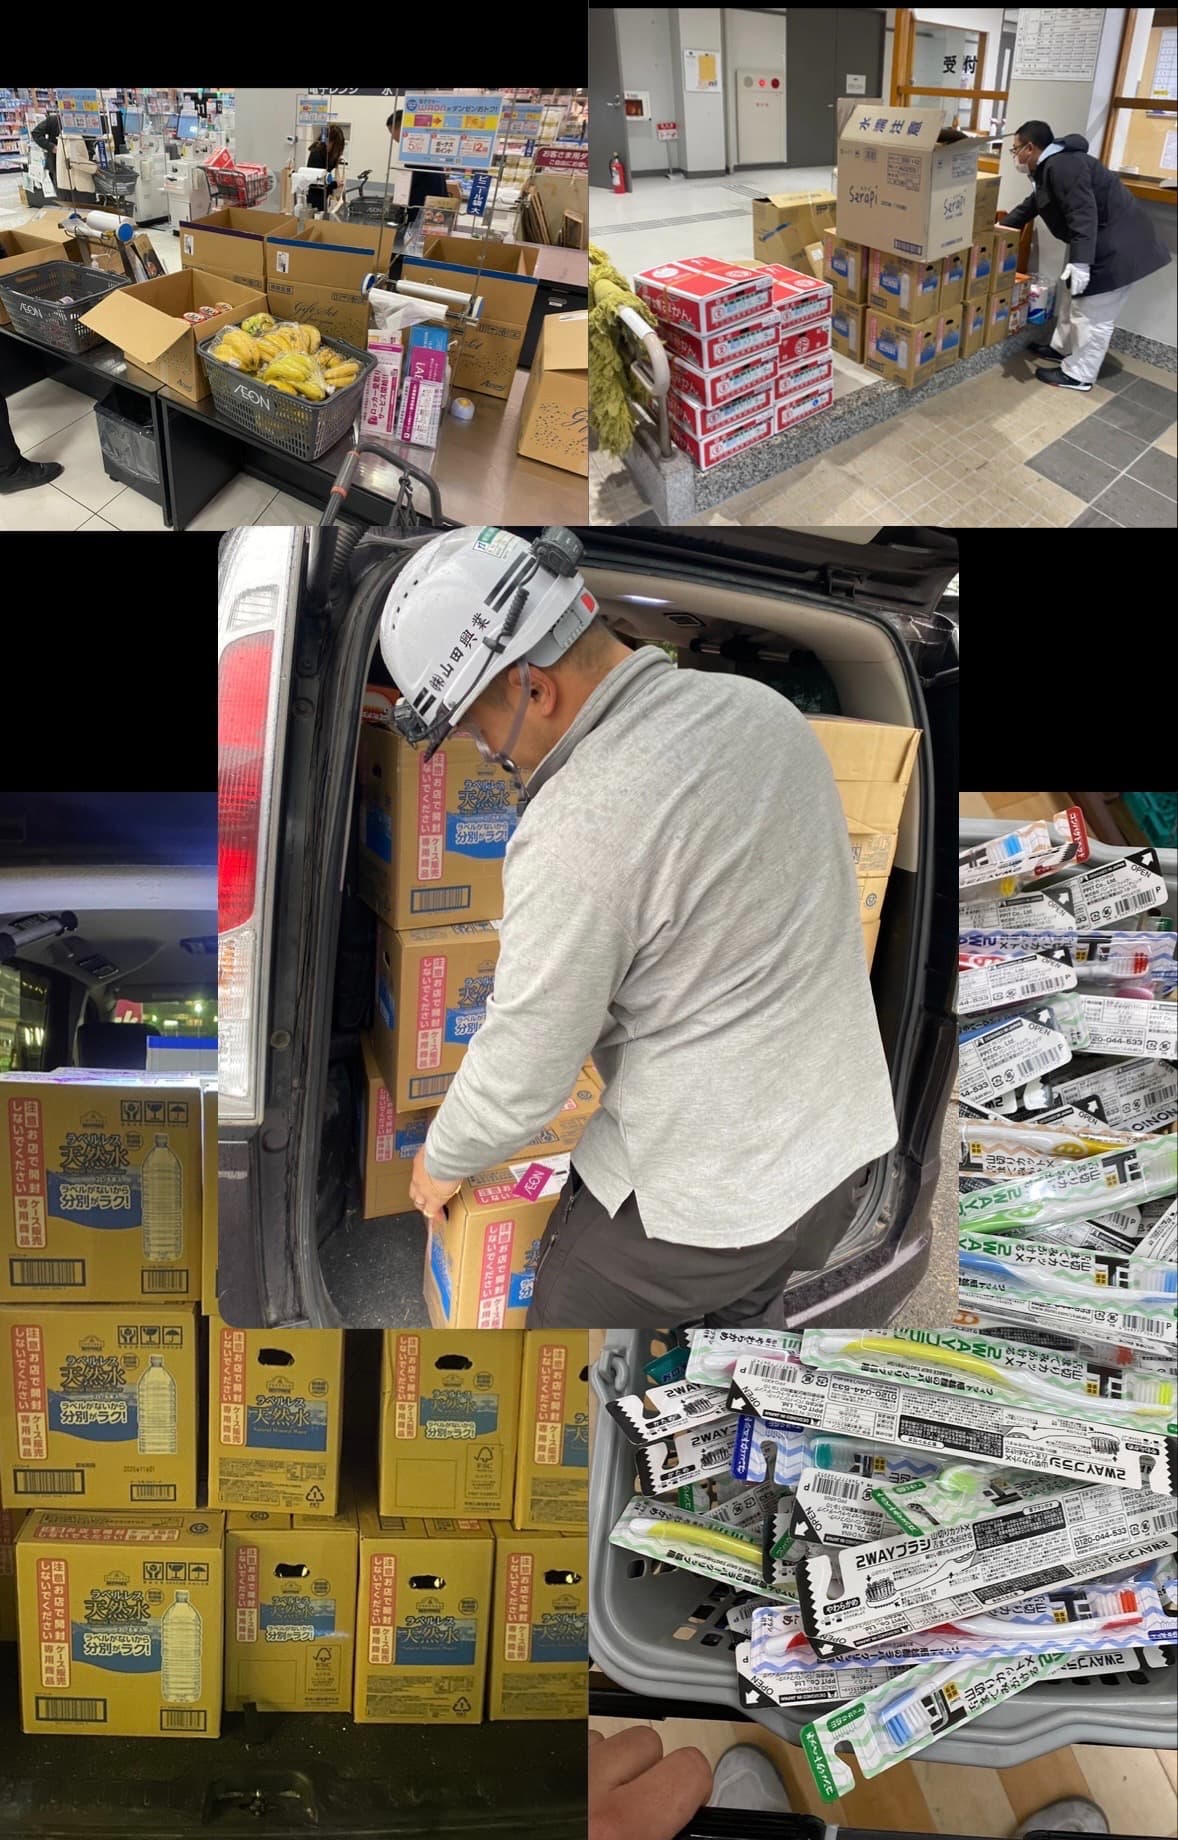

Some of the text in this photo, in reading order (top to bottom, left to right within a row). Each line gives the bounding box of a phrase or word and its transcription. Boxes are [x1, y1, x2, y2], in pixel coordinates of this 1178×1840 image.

[942, 55, 978, 74] 受付
[1131, 864, 1151, 878] OPEN
[1028, 1023, 1051, 1036] OPEN
[60, 1145, 130, 1168] 天然水
[60, 1367, 126, 1387] 天然水
[253, 1407, 311, 1425] 天然水
[691, 1427, 729, 1446] 2WAY
[1049, 1457, 1126, 1481] 2WAYブラシ
[855, 1538, 931, 1569] 2WAYブラシ
[84, 1600, 150, 1619] 天然水
[403, 1626, 460, 1644] 天然水
[750, 1675, 774, 1696] OPEN
